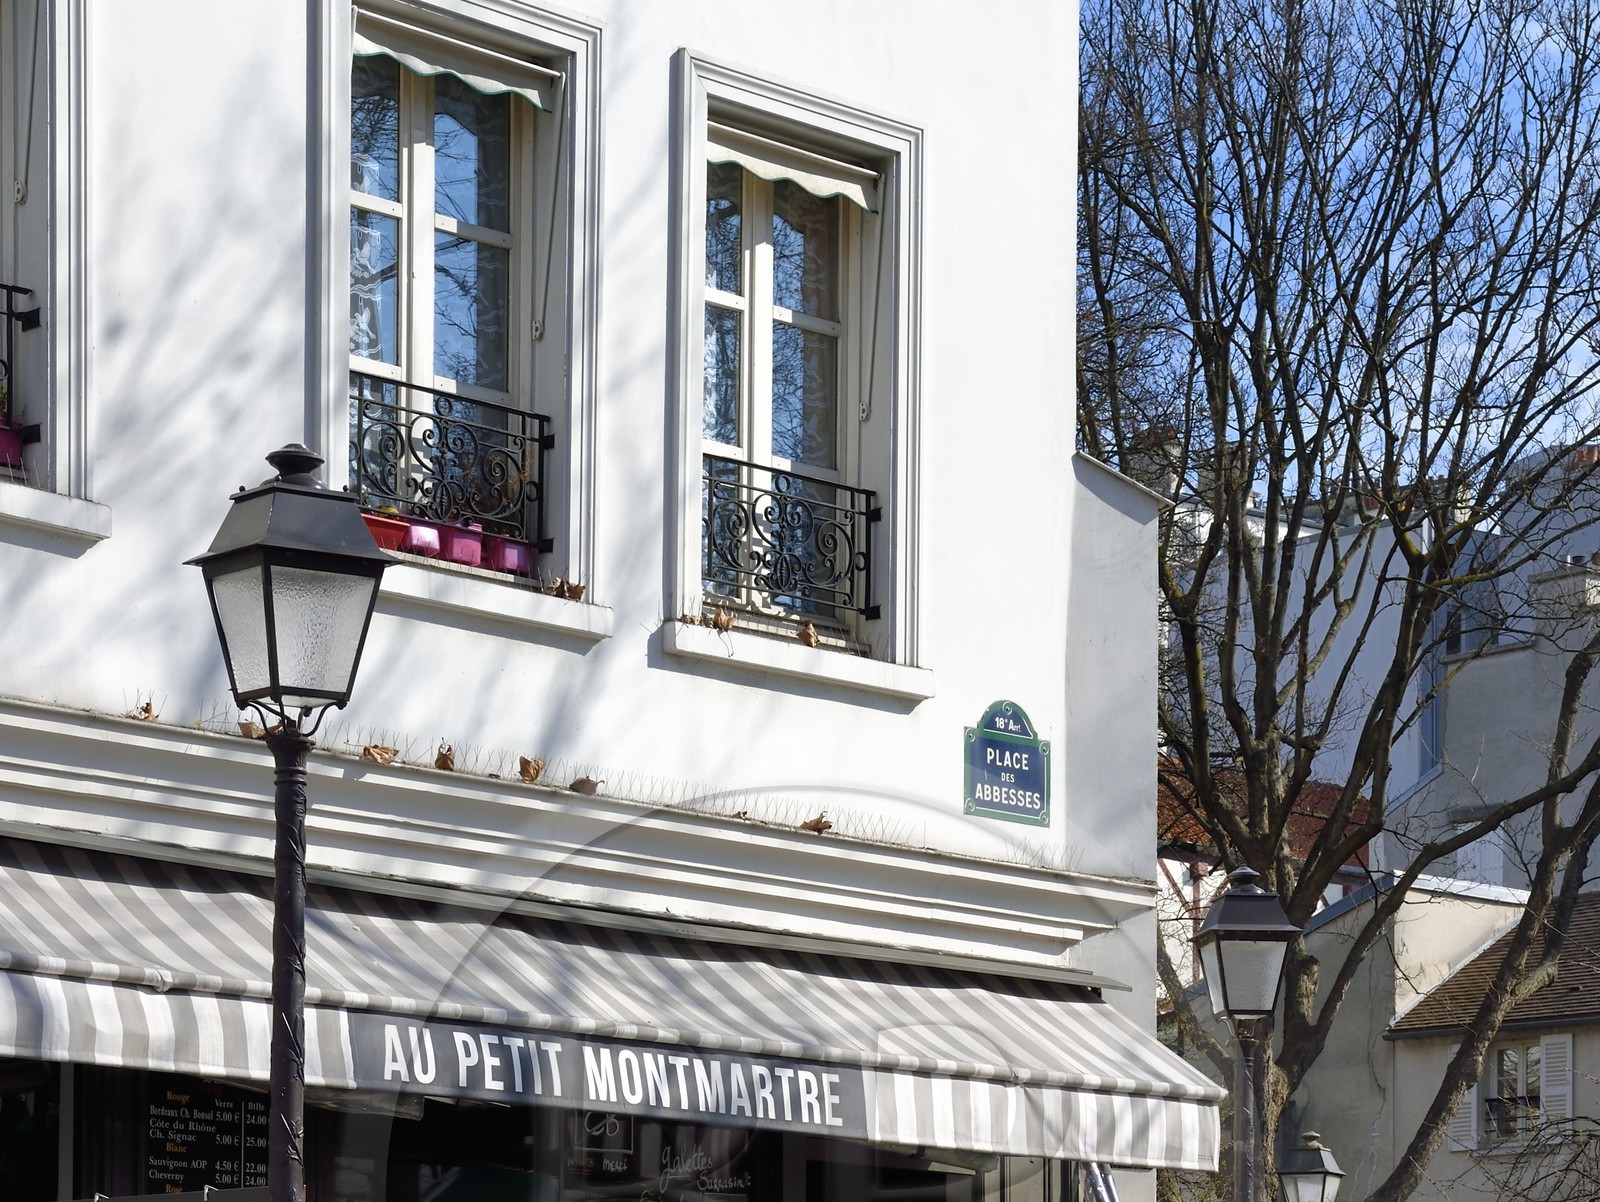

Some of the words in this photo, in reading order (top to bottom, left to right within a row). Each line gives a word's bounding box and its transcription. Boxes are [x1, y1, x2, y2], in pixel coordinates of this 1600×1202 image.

[987, 748, 1028, 770] PLACE
[1002, 772, 1014, 782] DES
[976, 783, 1040, 809] ABBESSES
[384, 1024, 436, 1085] AU
[452, 1032, 562, 1097] PETIT
[582, 1044, 844, 1127] MONTMARTRE
[166, 1090, 191, 1103] Rouge
[215, 1099, 234, 1108] Verre
[150, 1105, 178, 1117] Bordeaux
[216, 1111, 232, 1122] 5.00
[246, 1115, 267, 1125] 24.00
[149, 1118, 170, 1129] Côte
[173, 1120, 184, 1130] du
[189, 1120, 217, 1132] Rhône
[149, 1129, 164, 1139] Ch.
[168, 1131, 197, 1143] Signac
[216, 1135, 232, 1145] 5.00
[246, 1137, 266, 1148] 25.00
[166, 1143, 187, 1153] Blanc
[149, 1156, 188, 1170] Sauvignon
[190, 1160, 208, 1169] AOP
[215, 1161, 232, 1171] 4.50
[245, 1163, 266, 1174] 22.00
[149, 1170, 184, 1183] Cheverny
[215, 1173, 232, 1184] 5.00
[165, 1184, 183, 1193] Rosé
